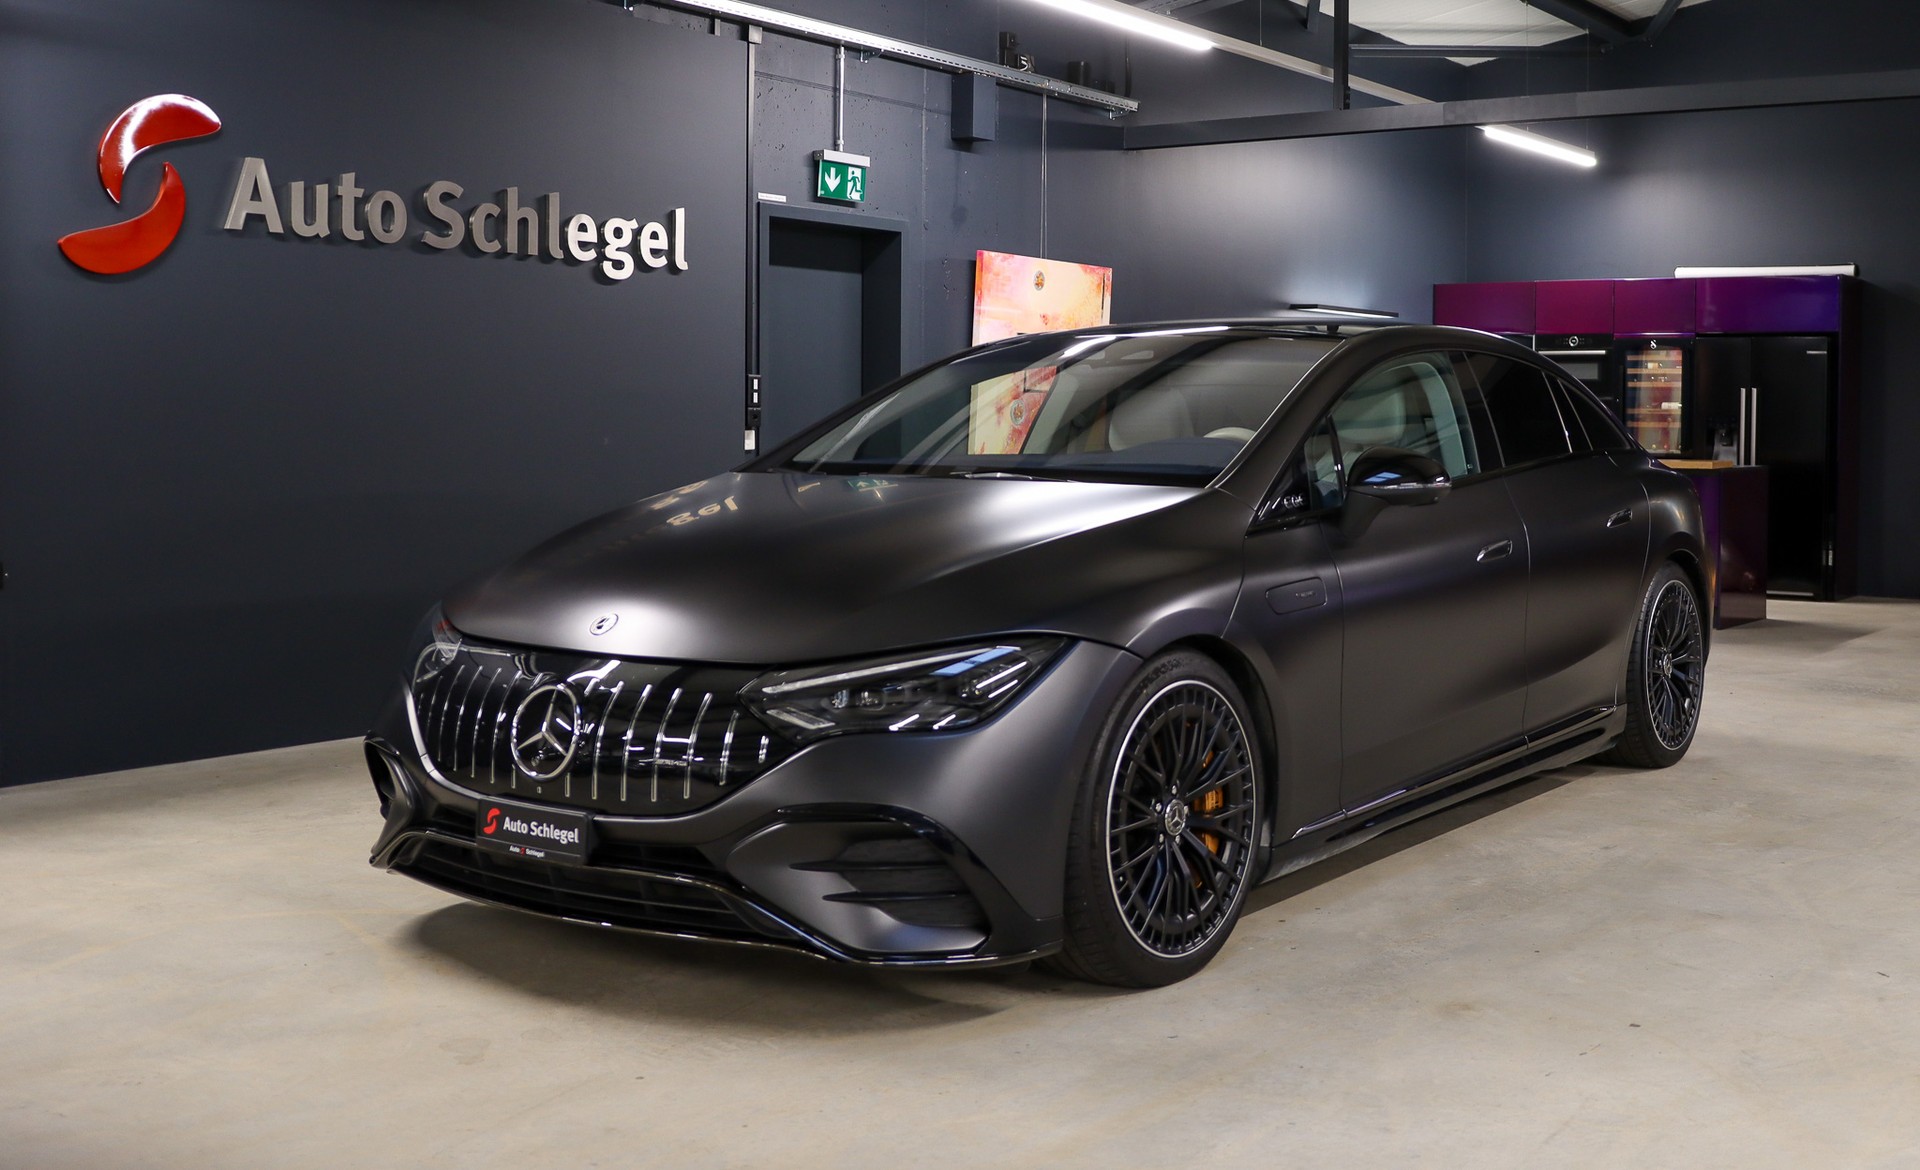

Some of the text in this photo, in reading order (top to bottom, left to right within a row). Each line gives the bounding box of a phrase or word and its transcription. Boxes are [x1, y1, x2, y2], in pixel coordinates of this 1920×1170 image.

[224, 156, 689, 281] Auto Schlegel
[503, 816, 579, 844] Auto Schlegel
[509, 845, 545, 858] Auto Schlegel
